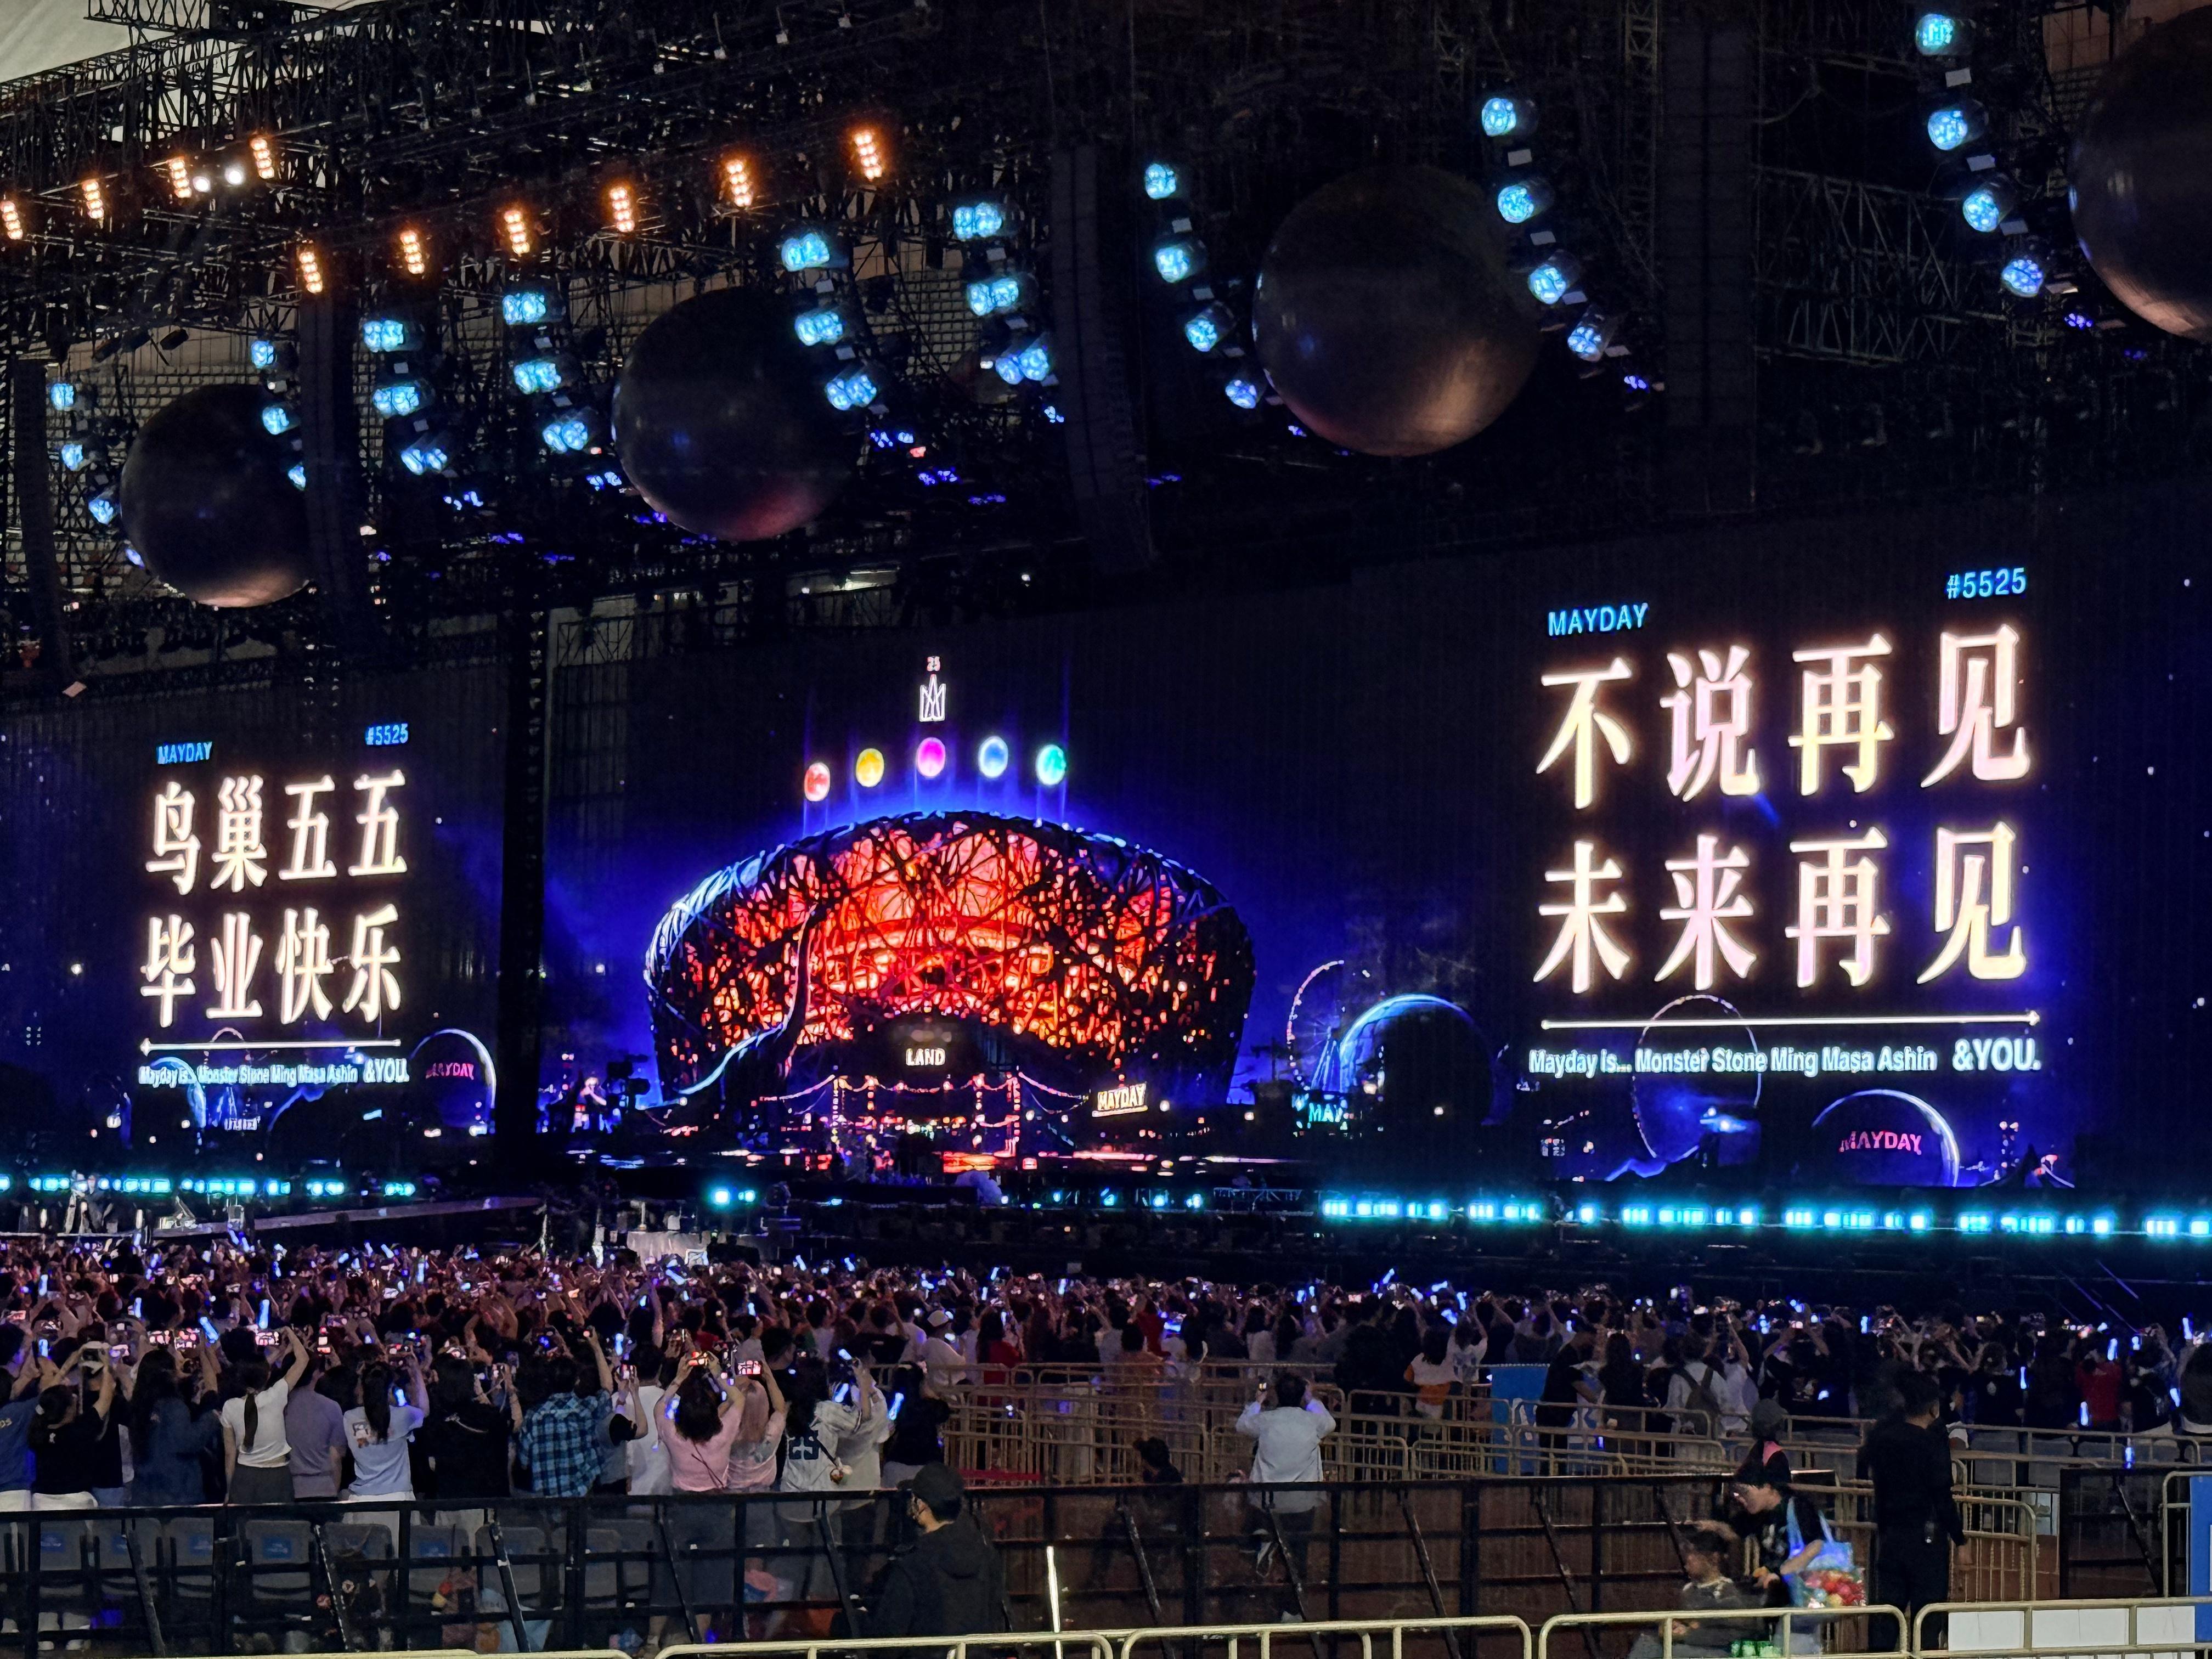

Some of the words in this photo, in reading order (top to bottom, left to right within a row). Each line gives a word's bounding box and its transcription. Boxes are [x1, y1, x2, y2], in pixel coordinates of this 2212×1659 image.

[1947, 567, 2027, 599] #5525
[1548, 603, 1648, 636] MAYDAY
[1536, 624, 2031, 809] 不说再见
[365, 723, 408, 745] #5525
[157, 741, 213, 764] MAYDAY
[145, 769, 407, 895] 鸟巢五五
[1533, 821, 2027, 994] 未来再见
[140, 904, 402, 1028] 毕业快乐
[905, 1048, 946, 1066] LAND
[1529, 1049, 1598, 1079] Mayday
[1635, 1048, 1710, 1073] Monster
[1712, 1047, 1768, 1073] Stone
[1770, 1047, 1818, 1077] Ming
[1822, 1046, 1875, 1072] Masa
[1877, 1045, 1938, 1071] Ashin
[1097, 1083, 1147, 1111] MAYDAY
